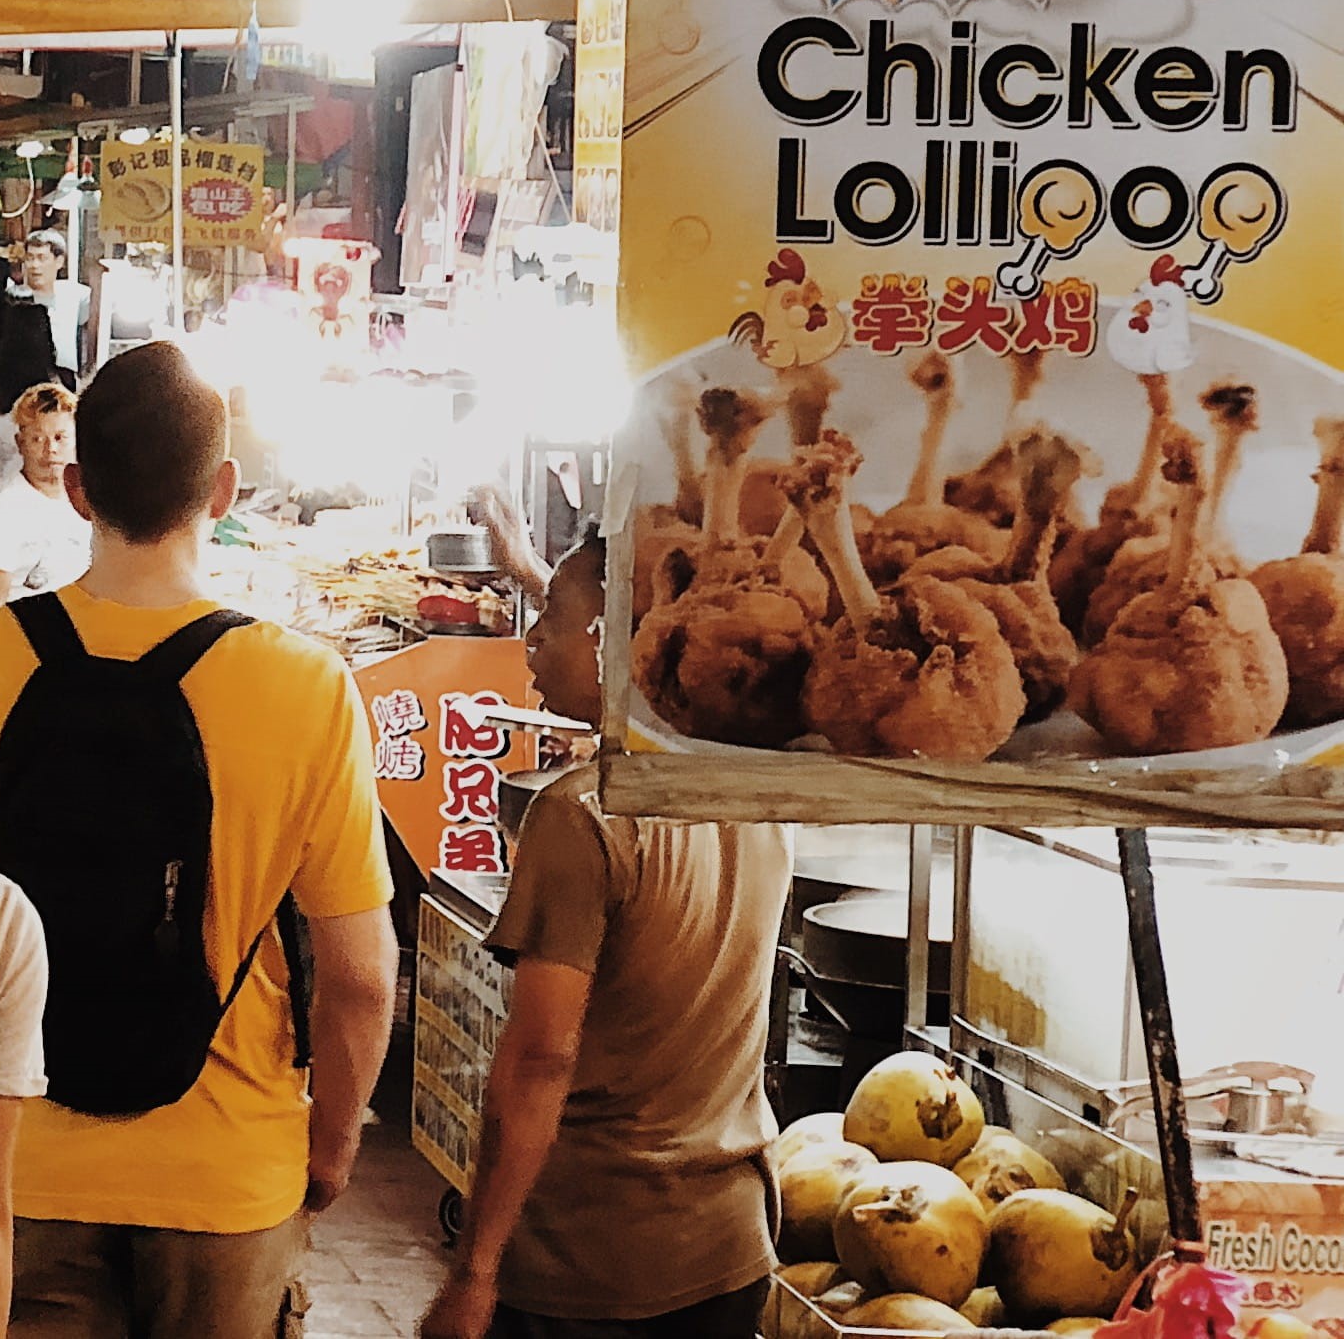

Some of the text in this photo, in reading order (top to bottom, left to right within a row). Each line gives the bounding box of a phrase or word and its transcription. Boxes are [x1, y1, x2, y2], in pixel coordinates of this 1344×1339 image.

[757, 16, 1296, 131] Chicken
[775, 137, 1287, 303] Lollipop
[852, 273, 1098, 356] 拳头鸡
[1205, 1220, 1344, 1271] Fresh Coco
